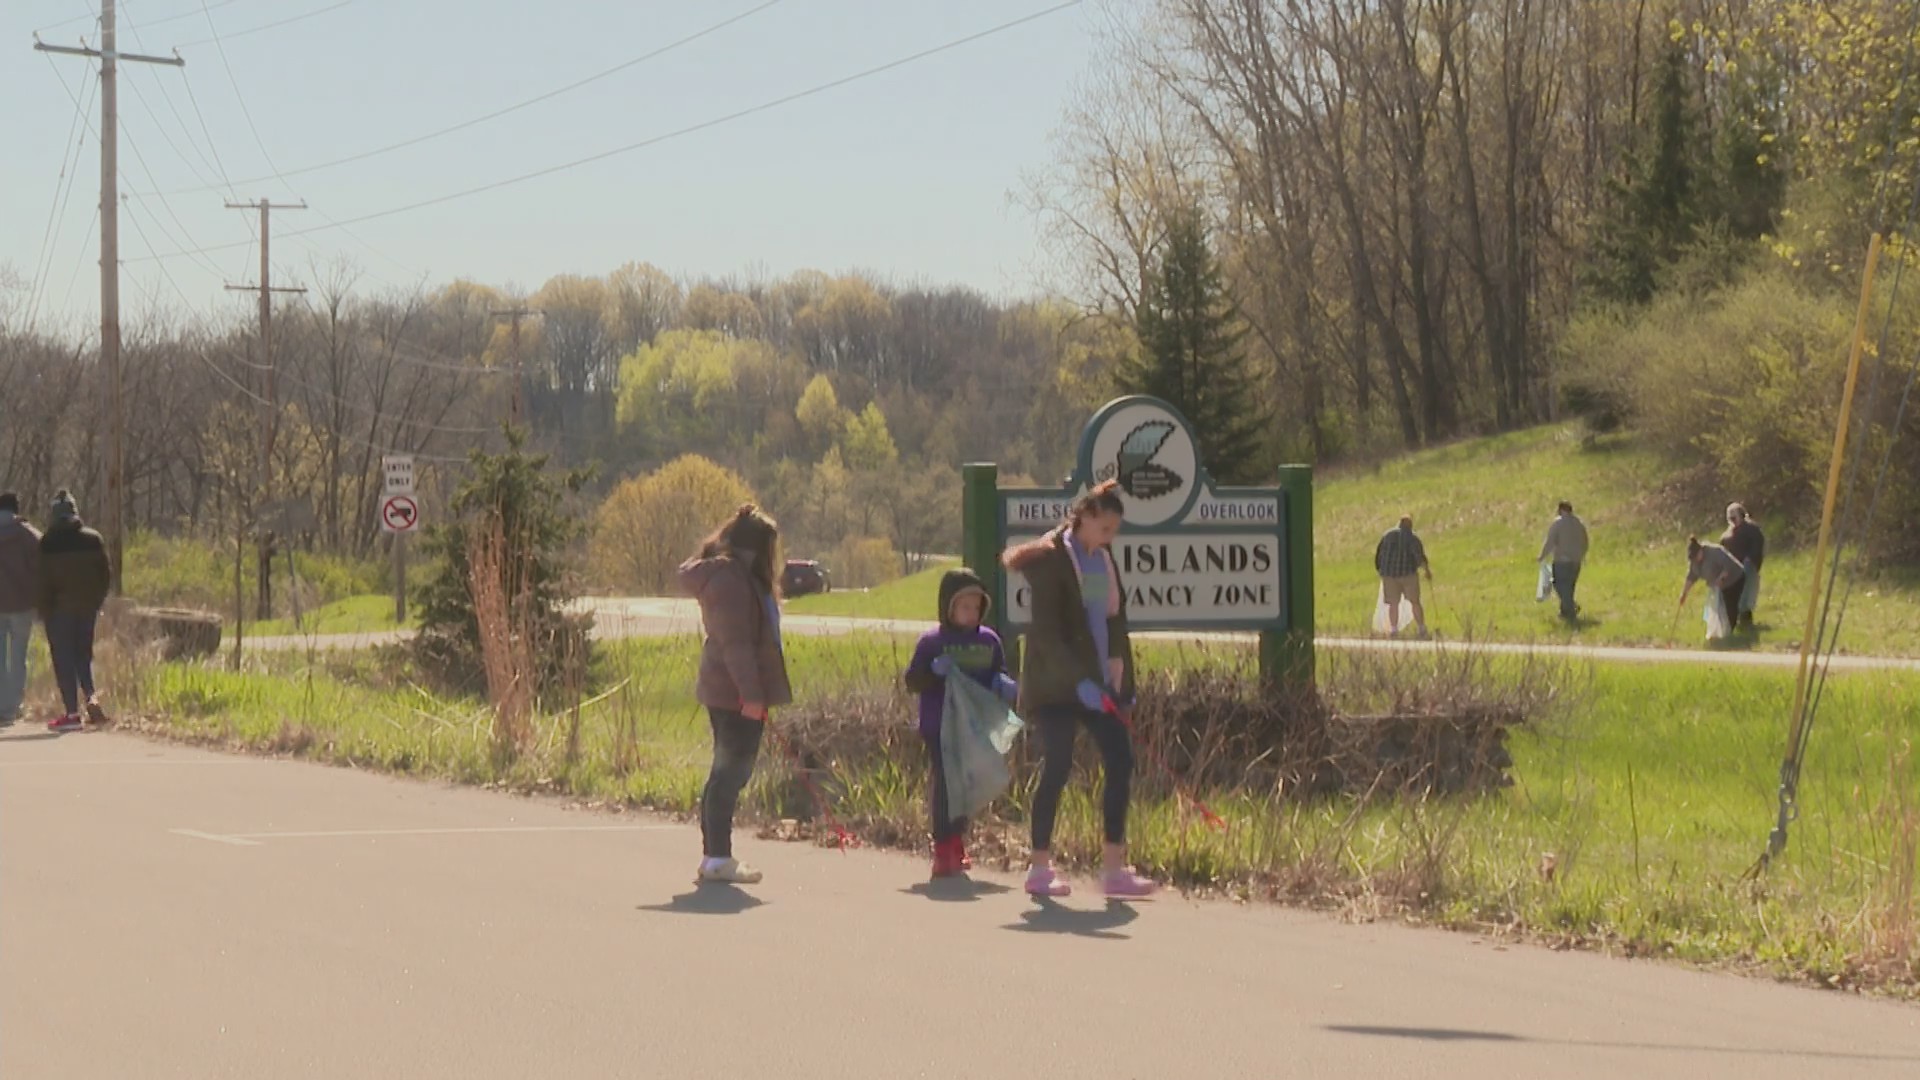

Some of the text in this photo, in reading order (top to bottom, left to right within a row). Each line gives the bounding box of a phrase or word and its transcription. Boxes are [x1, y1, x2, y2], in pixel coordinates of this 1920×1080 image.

[387, 463, 411, 473] ENTER
[388, 477, 410, 486] ONLY
[1199, 503, 1275, 520] OVERLOOK
[1123, 543, 1271, 574] ISLANDS
[1213, 583, 1272, 606] ZONE
